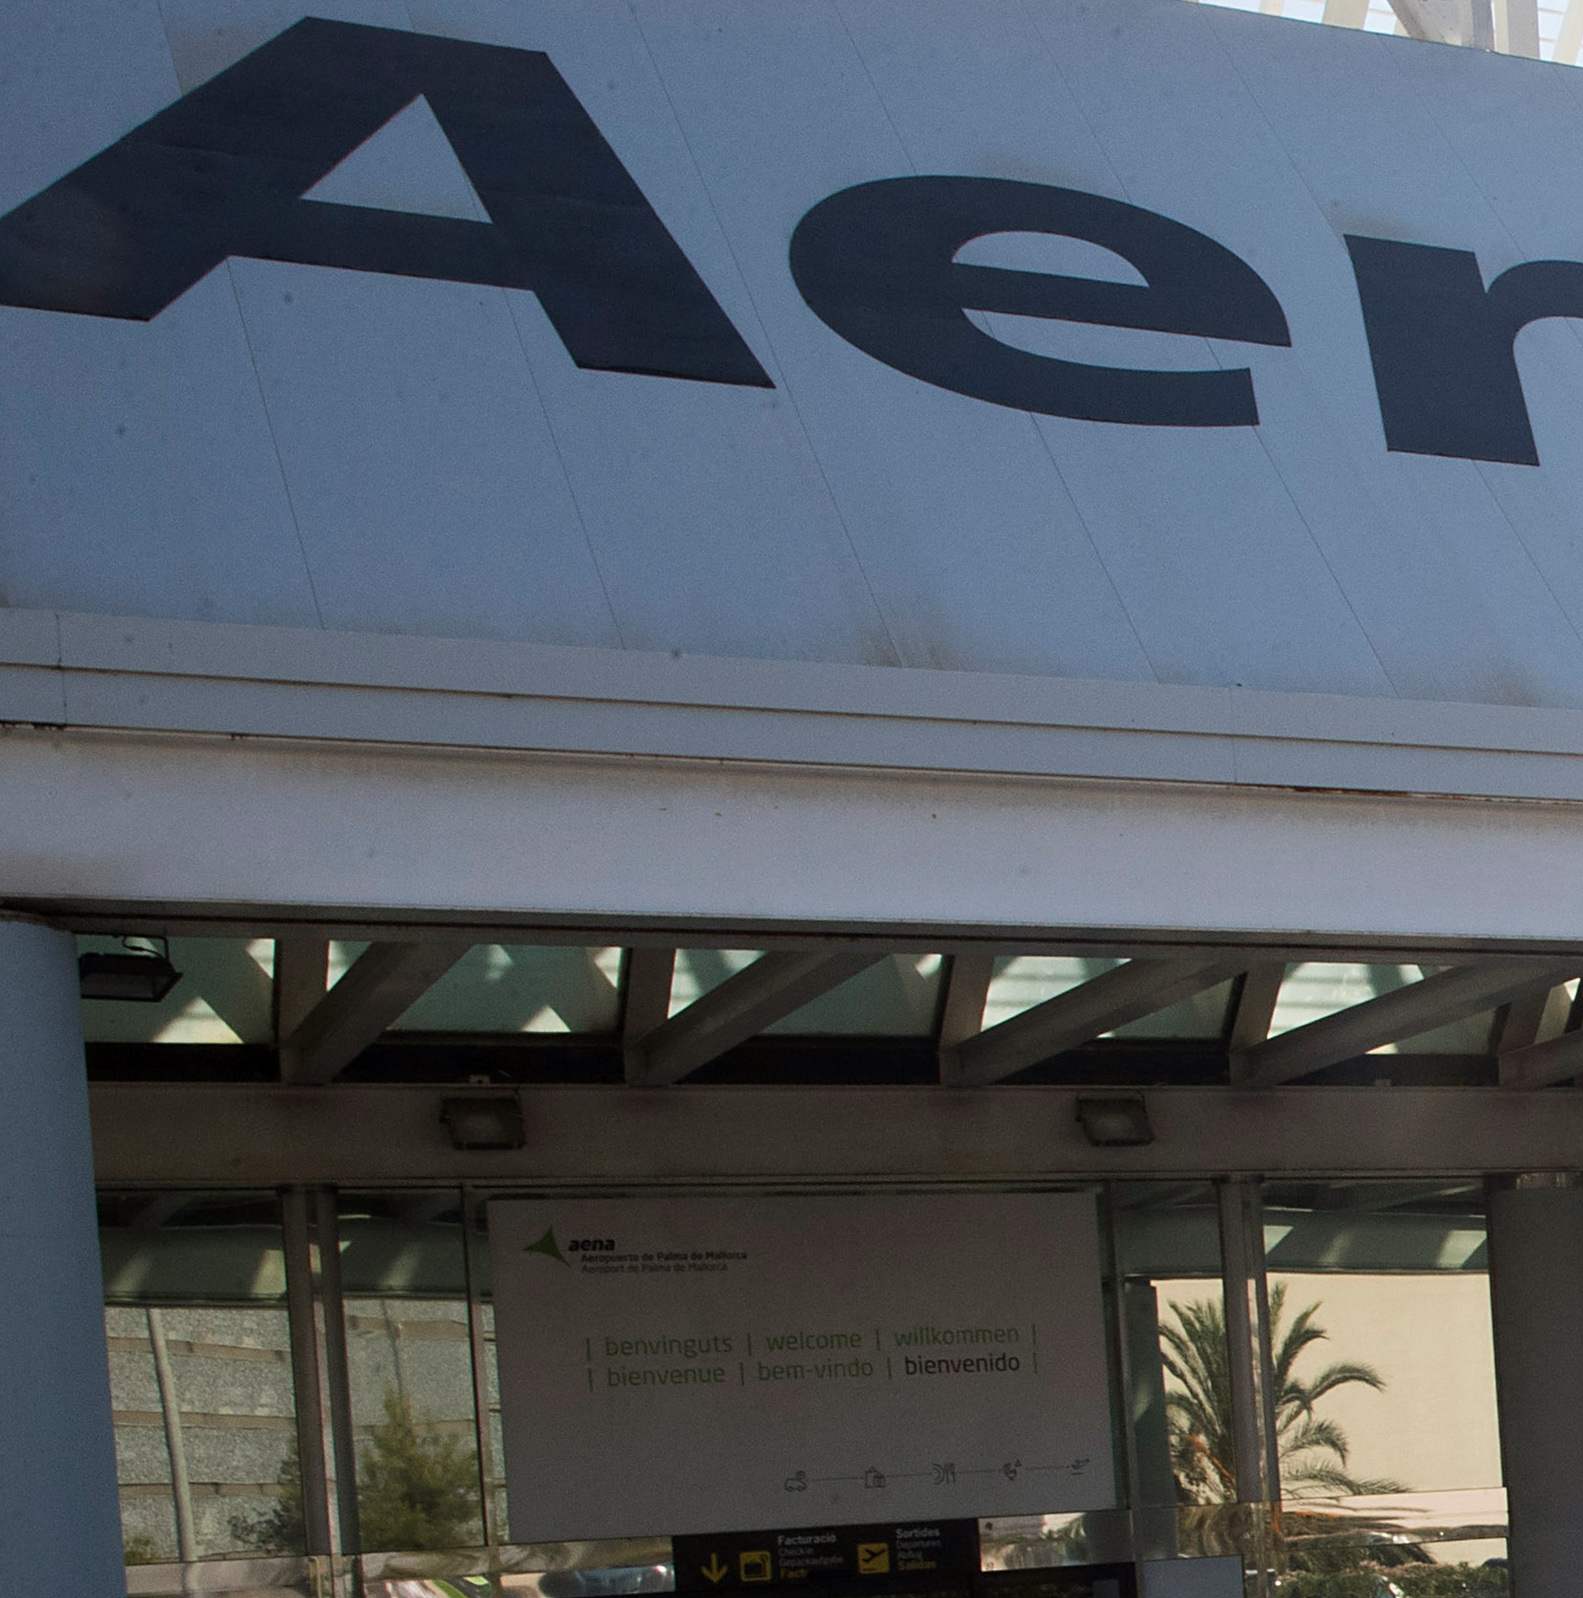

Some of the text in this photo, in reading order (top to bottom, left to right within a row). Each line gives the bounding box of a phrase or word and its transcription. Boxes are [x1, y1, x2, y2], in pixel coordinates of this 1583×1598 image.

[568, 1238, 615, 1252] aena
[605, 1326, 1019, 1361] benvinguts welcome willkommen
[607, 1352, 1020, 1387] bienvenue bem-vindo bienvenido
[777, 1532, 837, 1547] Facturació
